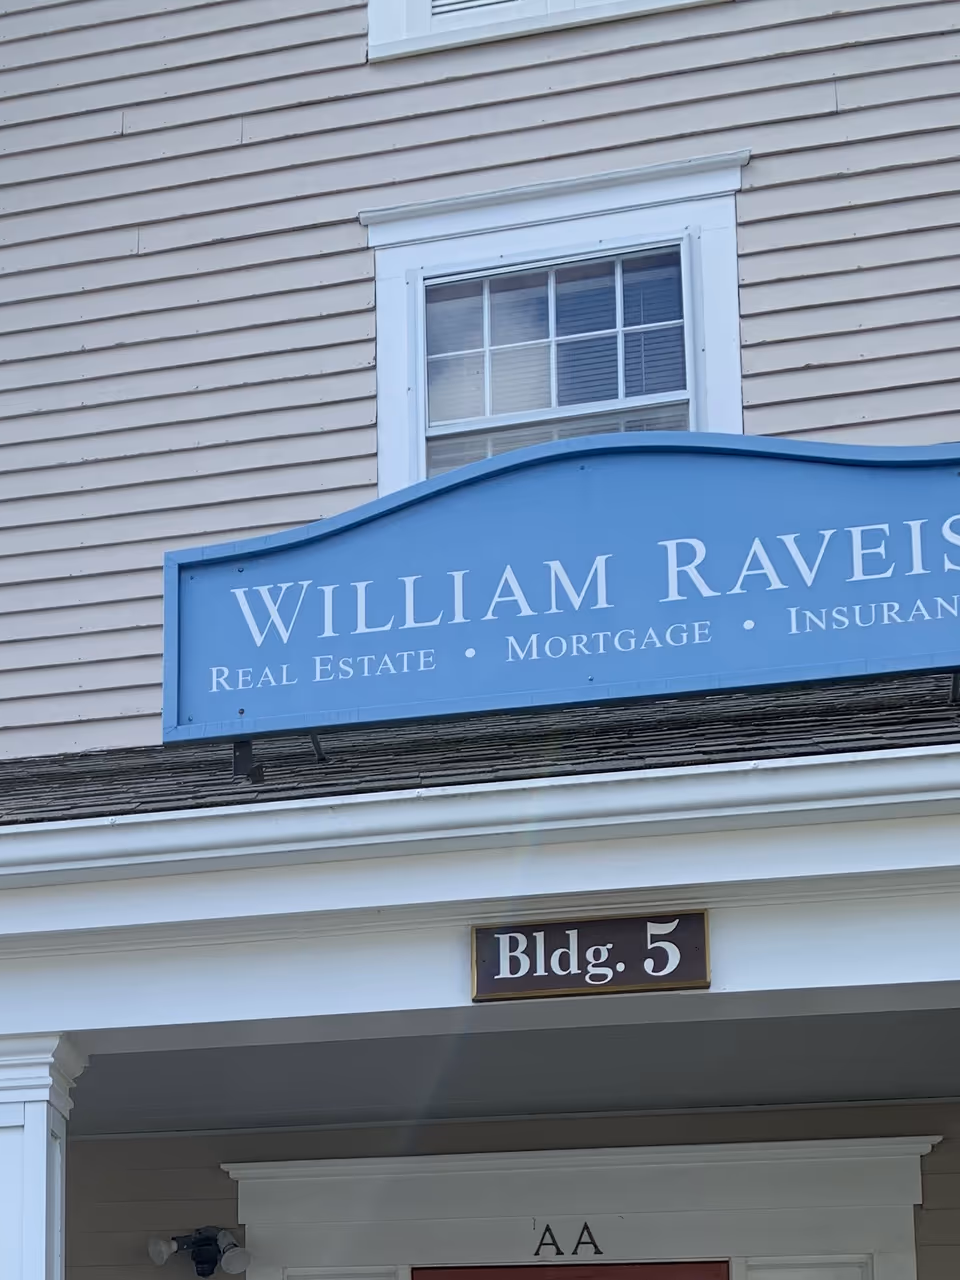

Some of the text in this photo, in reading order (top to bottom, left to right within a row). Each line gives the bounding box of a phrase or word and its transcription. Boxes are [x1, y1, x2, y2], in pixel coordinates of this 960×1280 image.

[231, 515, 960, 648] WILLIAM RAVEIS
[209, 594, 960, 693] REAL ESTATE MORTGAGE INSURAN
[493, 918, 681, 985] Bldg. 5
[533, 1221, 604, 1257] AA
